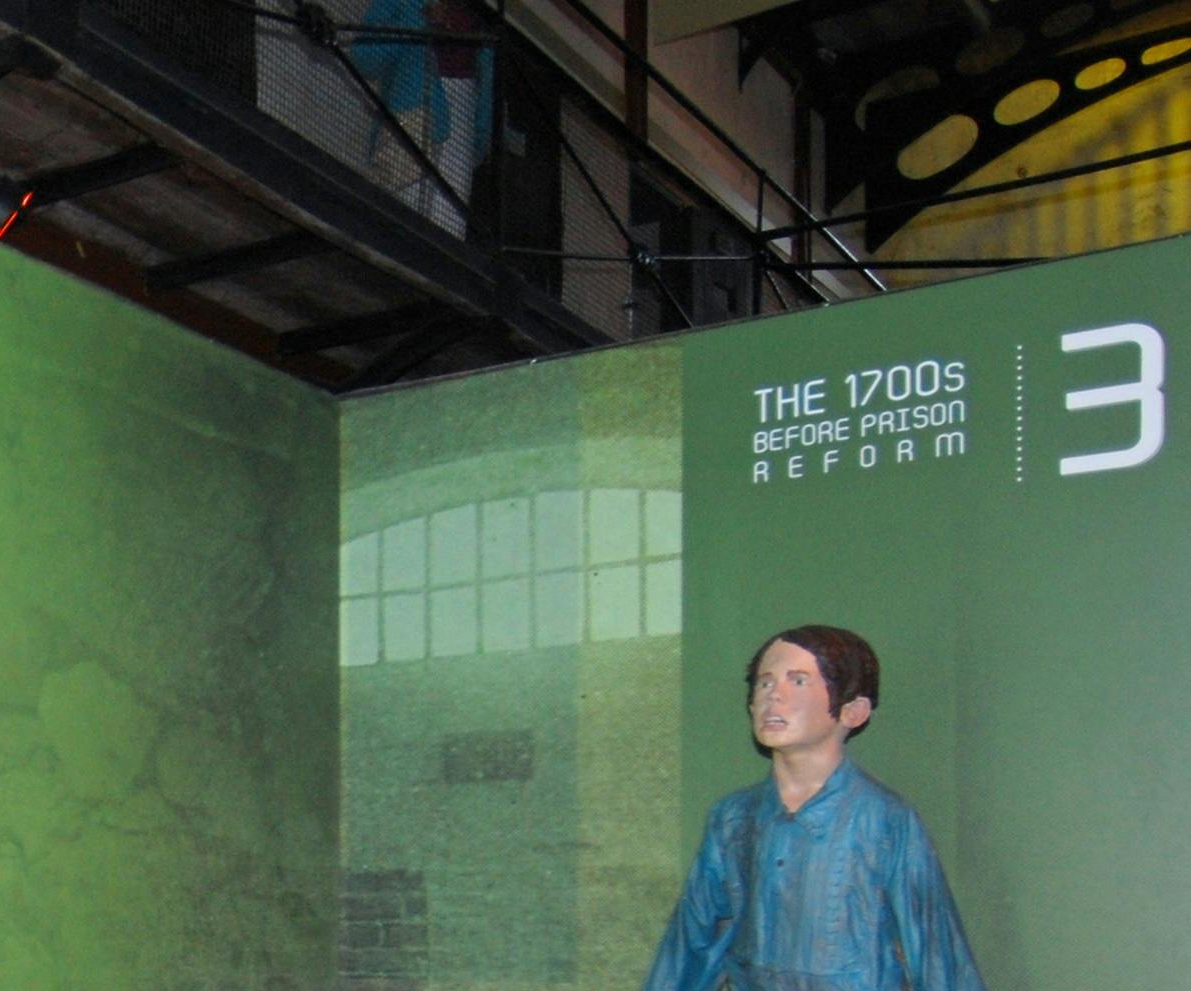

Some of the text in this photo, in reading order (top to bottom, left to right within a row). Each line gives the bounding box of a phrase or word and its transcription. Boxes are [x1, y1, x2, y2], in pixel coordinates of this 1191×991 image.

[754, 378, 825, 423] THE
[1059, 322, 1165, 476] 3
[753, 400, 965, 454] BEFORE PRISON
